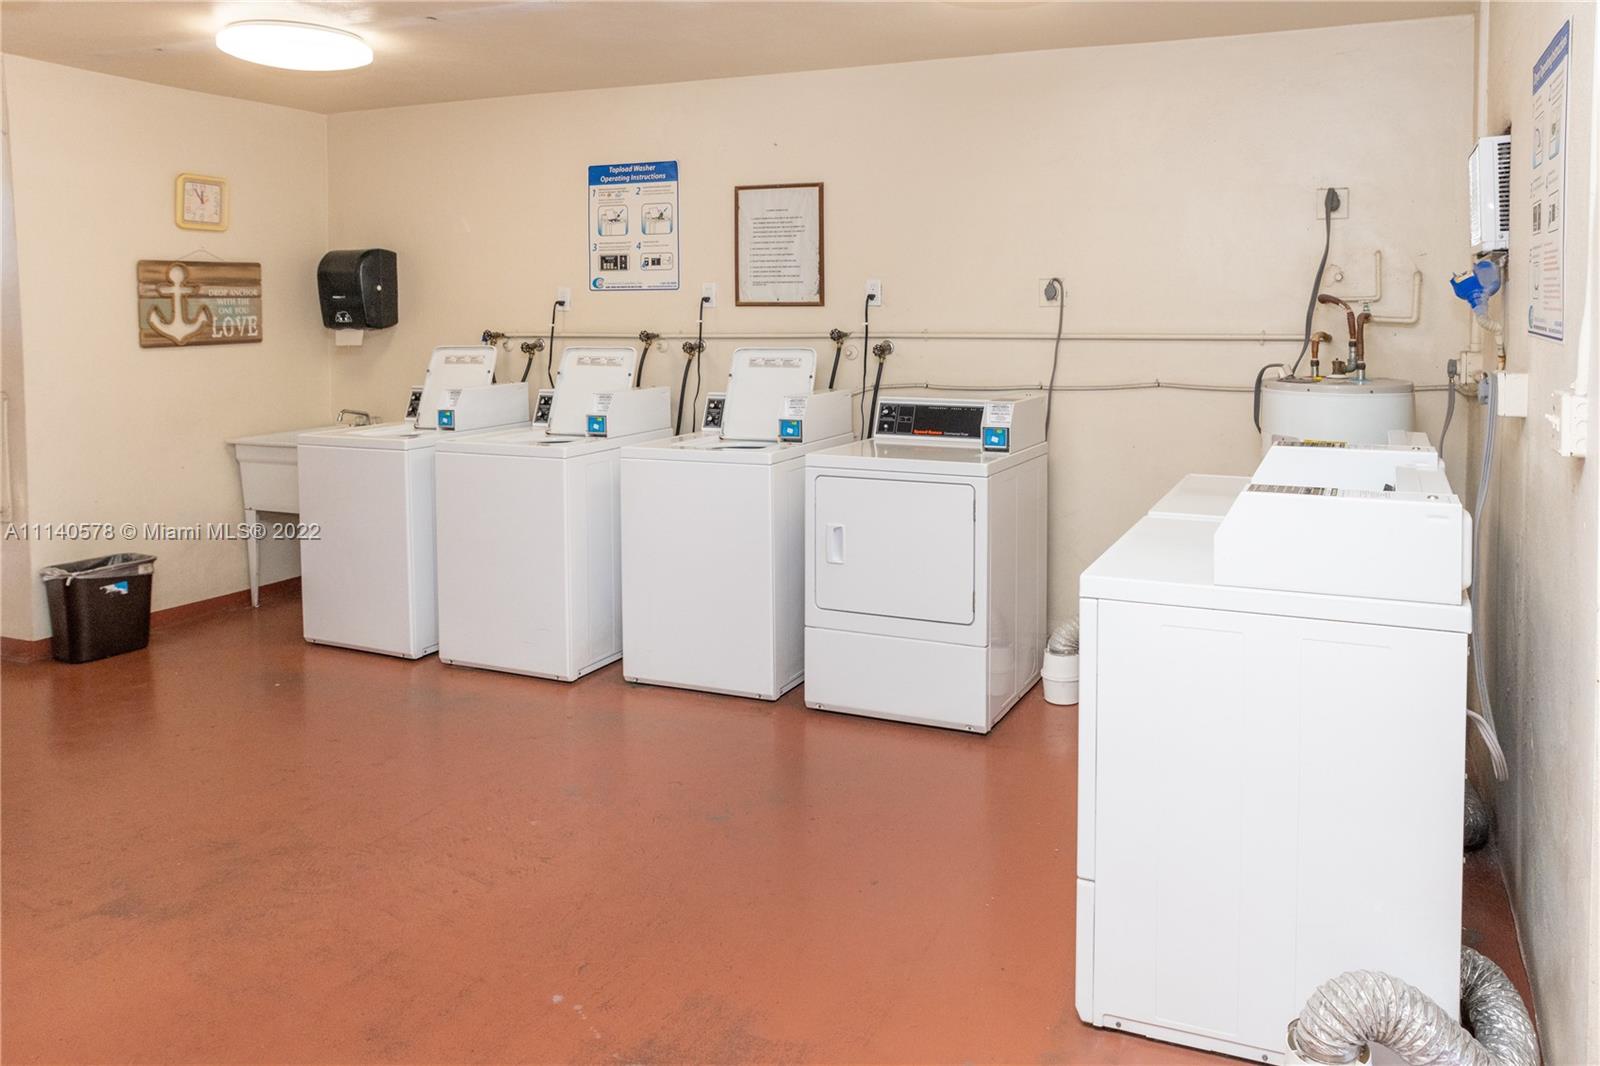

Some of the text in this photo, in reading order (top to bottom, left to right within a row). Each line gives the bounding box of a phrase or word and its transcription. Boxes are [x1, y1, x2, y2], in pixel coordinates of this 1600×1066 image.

[609, 164, 656, 174] Topload Washer
[600, 173, 666, 183] Operating Instructions
[635, 186, 641, 196] 2
[592, 243, 598, 252] 3
[636, 241, 641, 250] 4
[208, 288, 228, 297] DROP
[212, 315, 258, 338] LOVE
